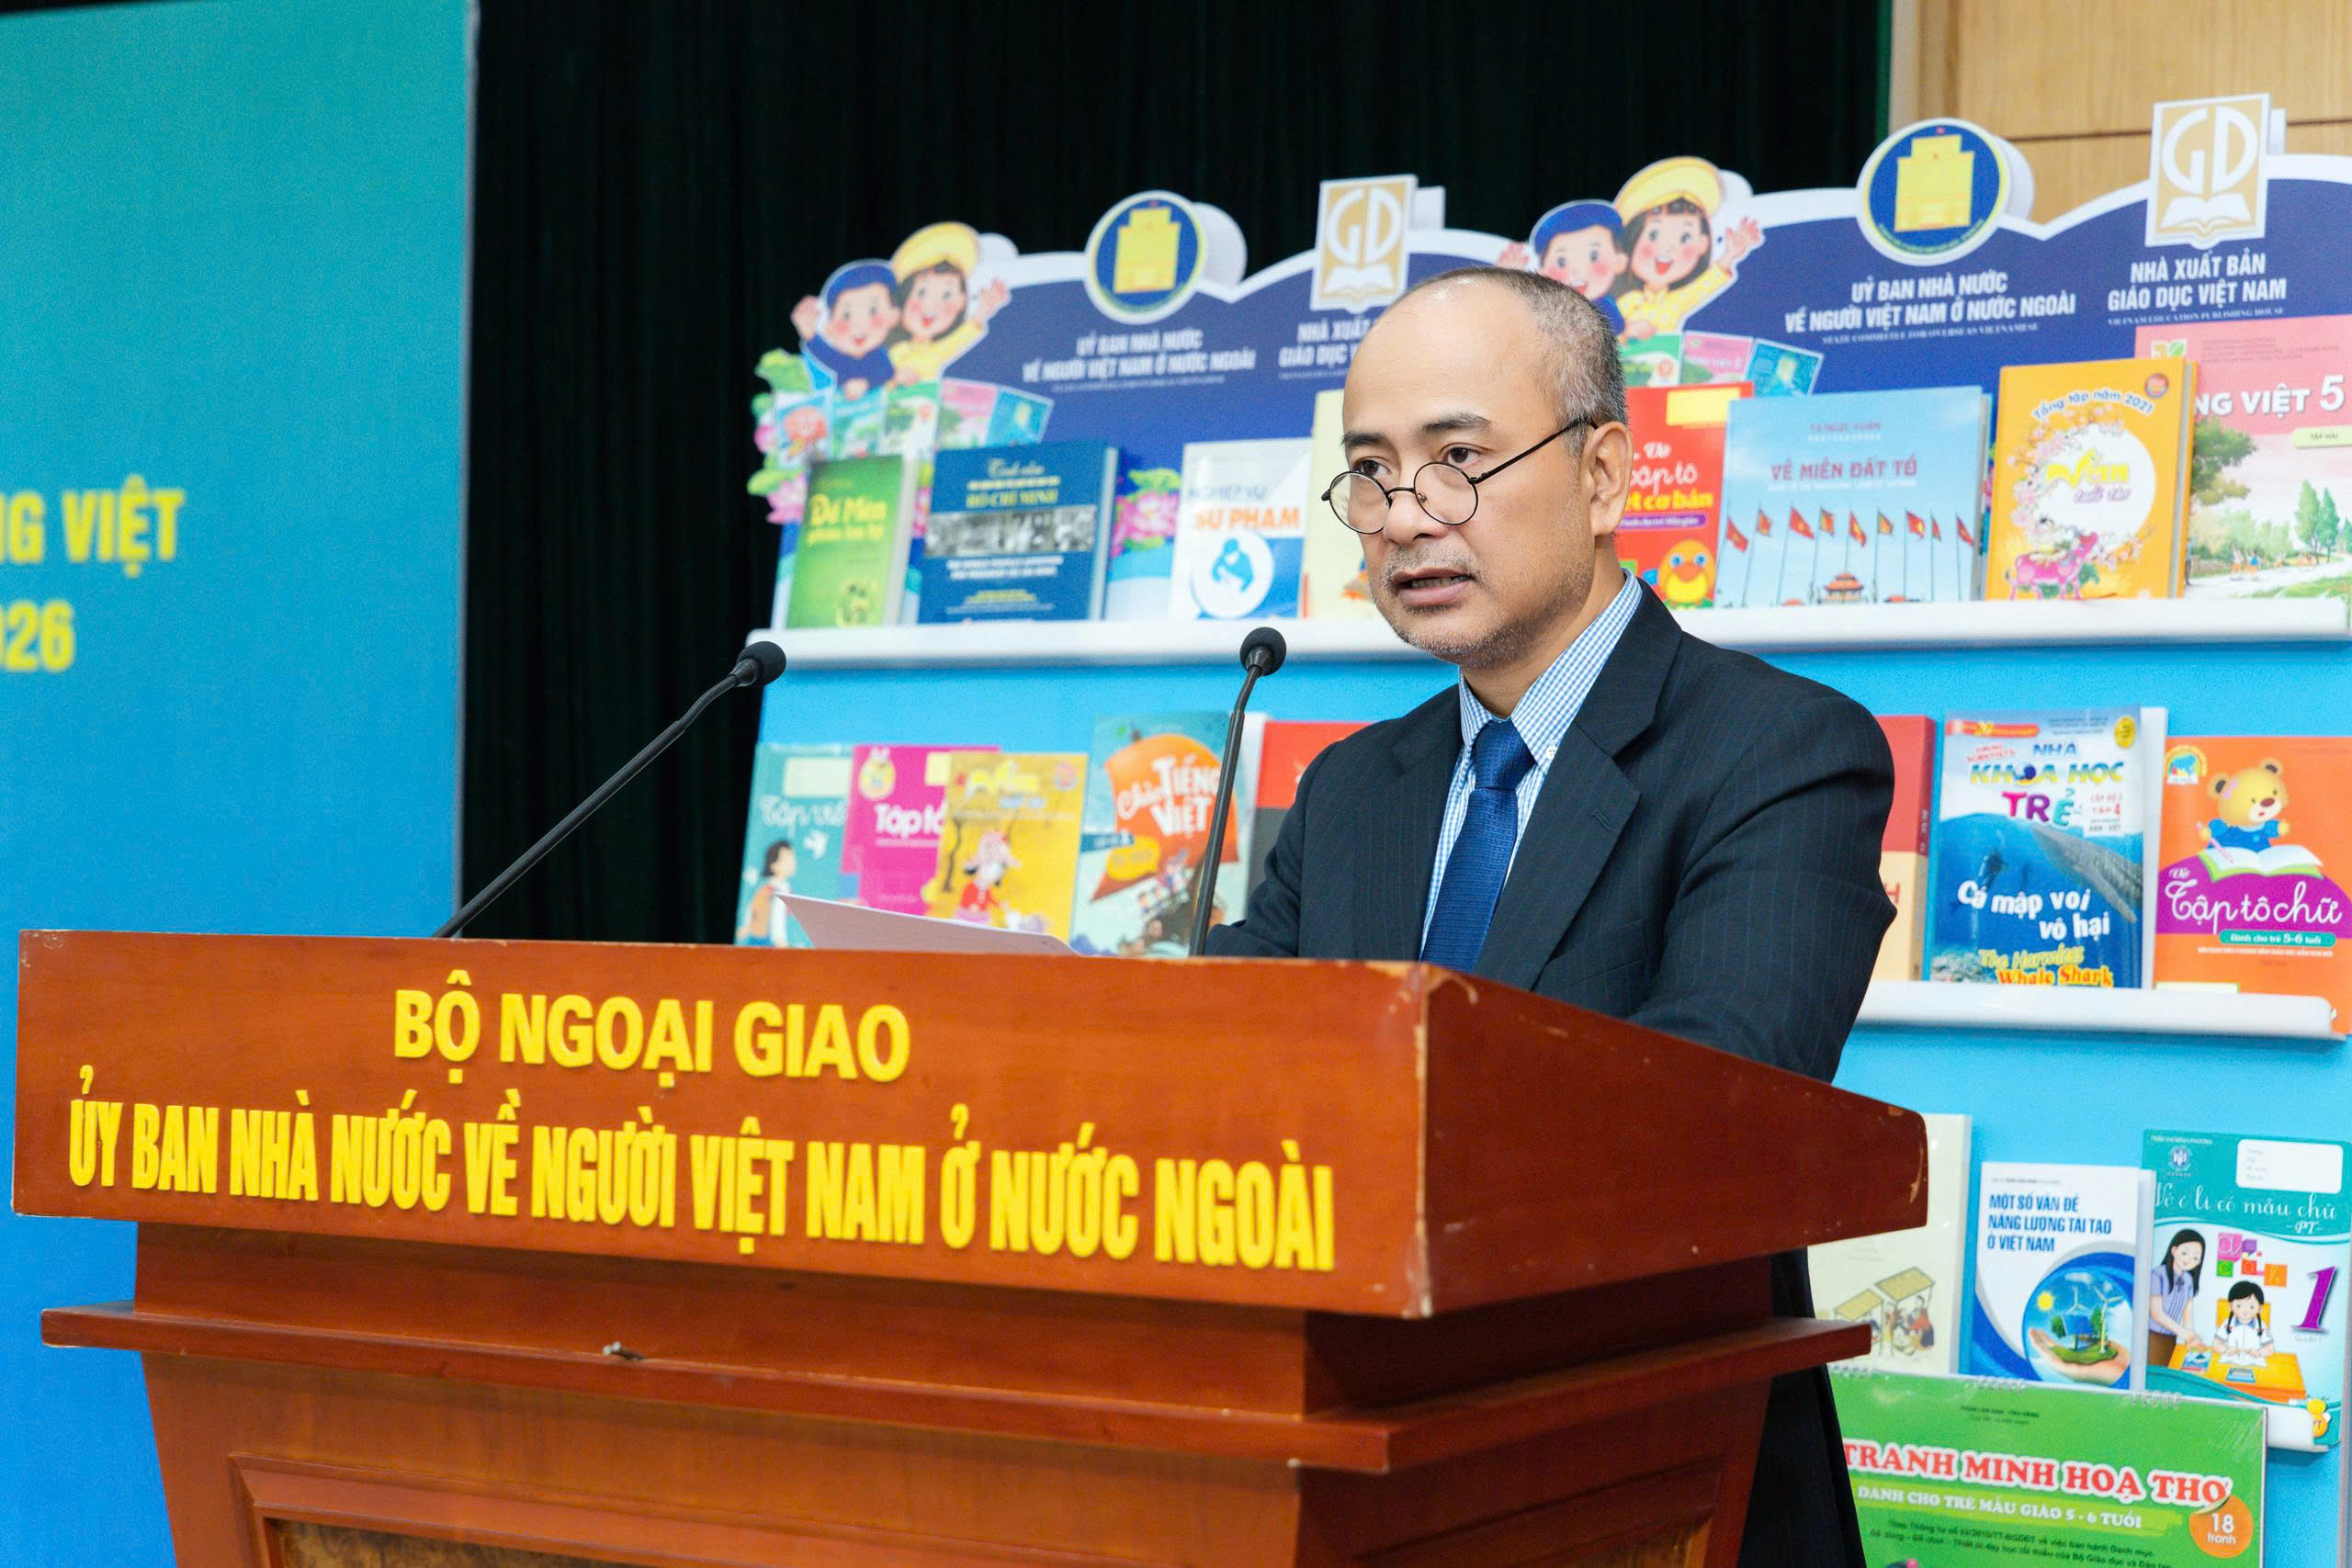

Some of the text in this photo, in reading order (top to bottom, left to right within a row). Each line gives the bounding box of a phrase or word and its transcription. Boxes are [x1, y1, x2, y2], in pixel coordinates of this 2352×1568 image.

[1877, 278, 1915, 300] BAN
[1917, 272, 1955, 299] NHÀ
[1959, 268, 2008, 297] NƯỚC
[2130, 246, 2267, 283] NHÀ XUẤT BẢN
[1785, 289, 2077, 333] VỀ NGƯỜI VIỆT NAM Ở NƯỚC NGOÀI
[2108, 277, 2288, 312] GIÁO DỤC VIỆT NAM
[2241, 382, 2312, 421] VIỆT
[2319, 374, 2346, 413] 5
[1800, 456, 1844, 480] MIỀN
[1849, 454, 1887, 479] ĐẤT
[0, 472, 185, 579] G VIỆT
[0, 599, 74, 671] 26
[1149, 795, 1213, 839] VIỆT
[2001, 787, 2075, 827] TRẺ
[1957, 879, 2091, 920] Cá mập voi
[2165, 878, 2344, 935] Tập tô chữ
[2038, 910, 2111, 942] vô hại
[2057, 963, 2114, 988] Shark
[395, 969, 910, 1088] BỘ NGOẠI GIAO
[69, 1064, 1335, 1271] ỦY BAN NHÀ NƯỚC VỀ NGƯỜI VIỆT NAM Ở NƯỚC NGOÀI
[1989, 1193, 2016, 1211] MỘT
[2017, 1191, 2033, 1211] SỐ
[1988, 1213, 2021, 1231] NĂNG
[1998, 1233, 2024, 1251] VIỆT
[2025, 1236, 2055, 1253] NAM
[2291, 1265, 2337, 1334] 1
[1843, 1442, 1956, 1477] TRANH
[1963, 1454, 2055, 1487] MINH
[2152, 1473, 2231, 1504] THƠ
[1857, 1483, 1905, 1503] DÀNH
[1906, 1491, 1941, 1506] CHO
[1943, 1494, 1976, 1510] TRẺ
[1978, 1495, 2017, 1515] MẪU
[2019, 1501, 2063, 1520] GIÁO
[2065, 1507, 2075, 1521] 5
[2086, 1512, 2098, 1524] 6
[2100, 1509, 2143, 1529] TUỔI
[2211, 1513, 2235, 1534] 18
[2206, 1531, 2236, 1546] tranh
